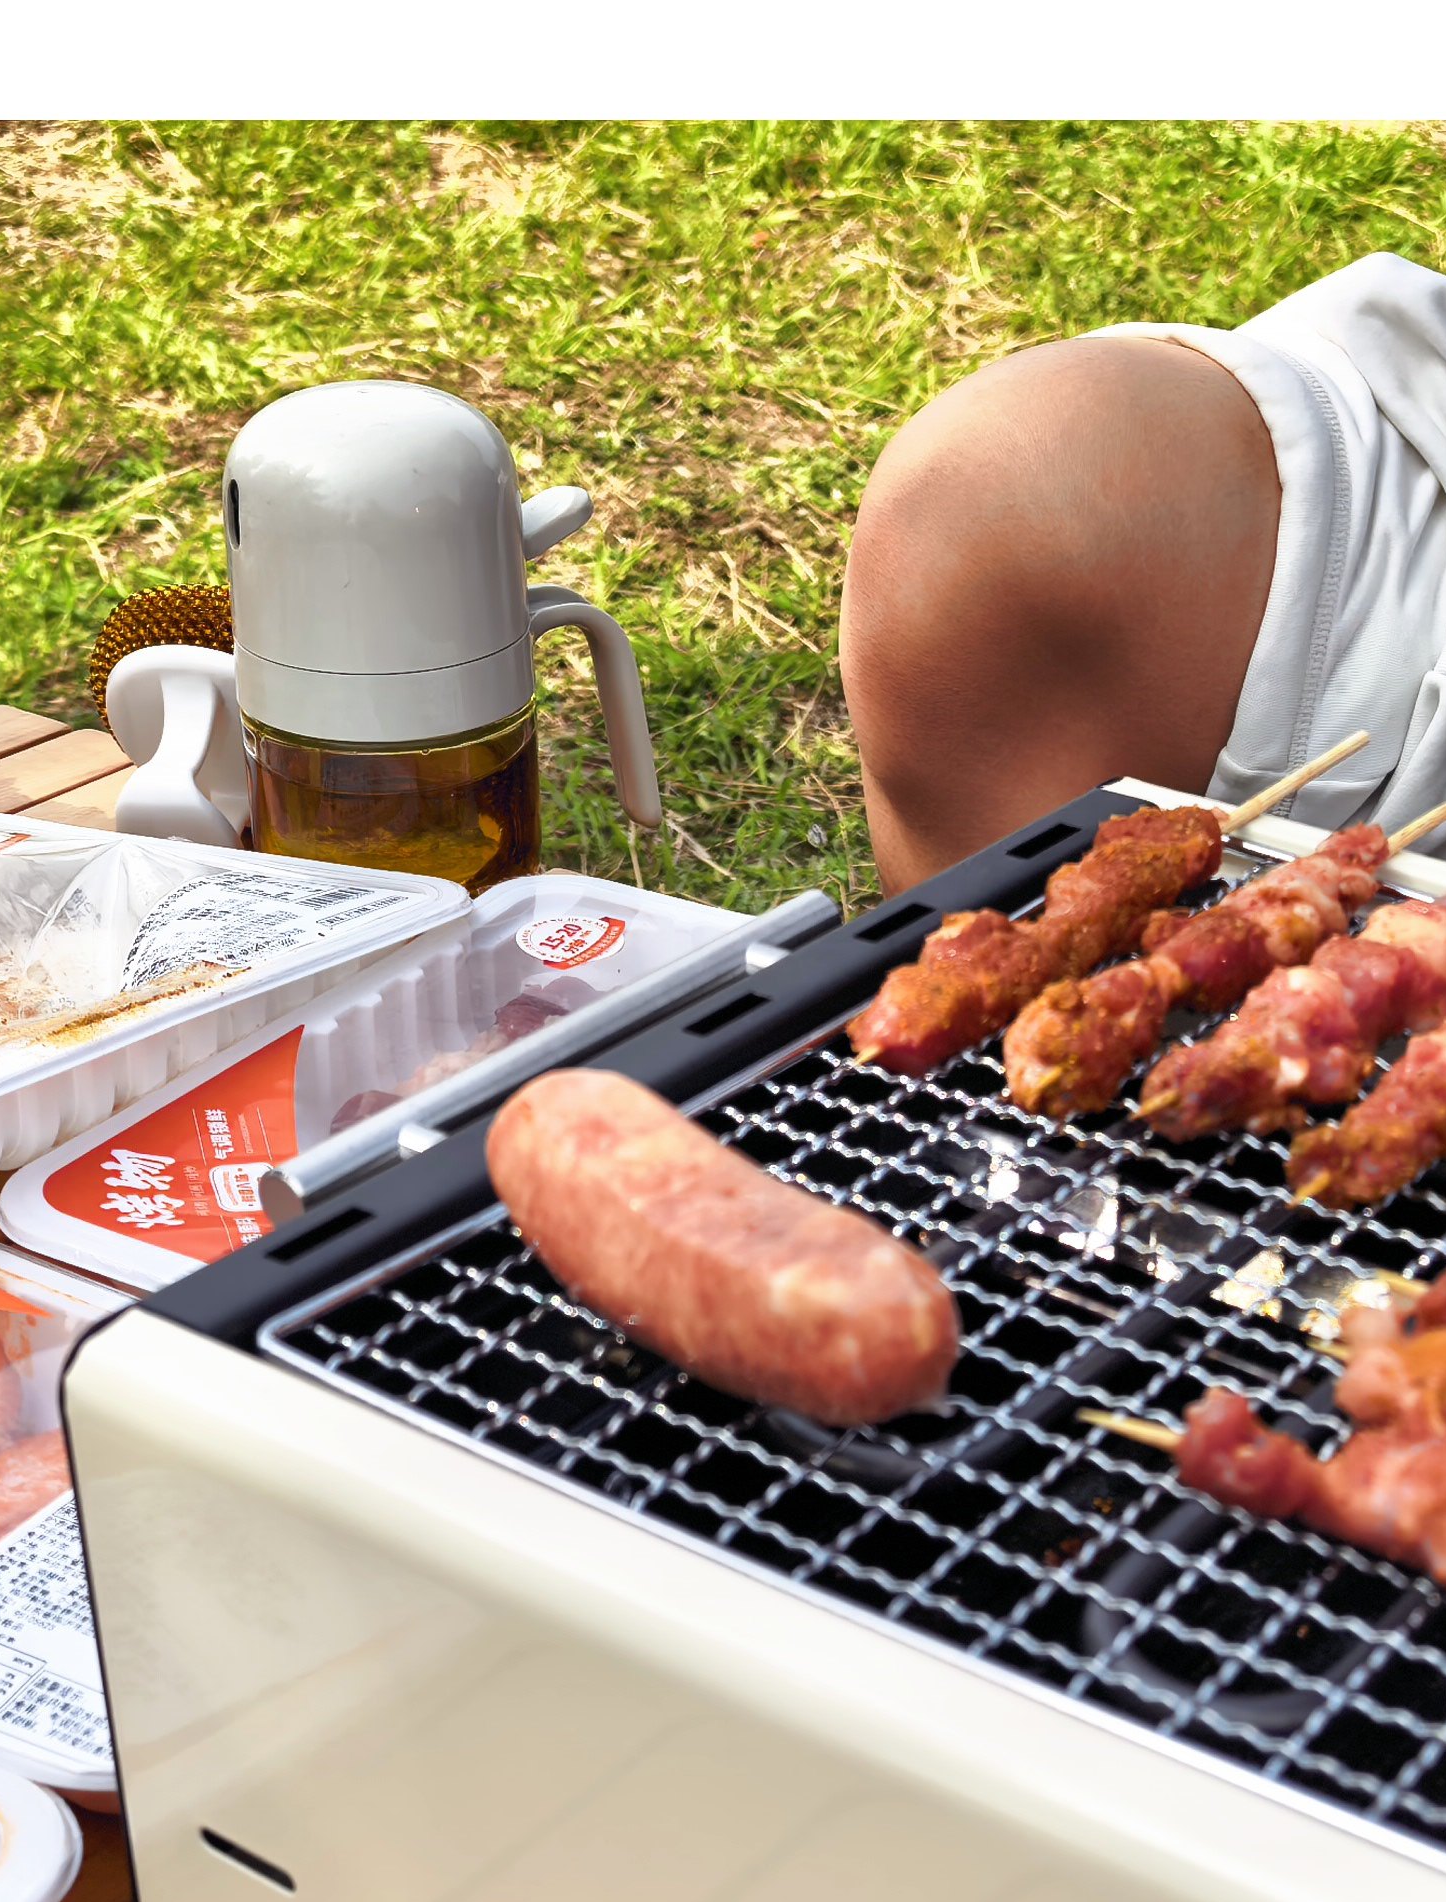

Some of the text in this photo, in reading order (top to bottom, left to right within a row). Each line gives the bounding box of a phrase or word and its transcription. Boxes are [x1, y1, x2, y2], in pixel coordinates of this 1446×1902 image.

[539, 922, 582, 949] 15-20
[205, 1108, 234, 1159] 气调锁鲜
[101, 1148, 185, 1228] 烤物
